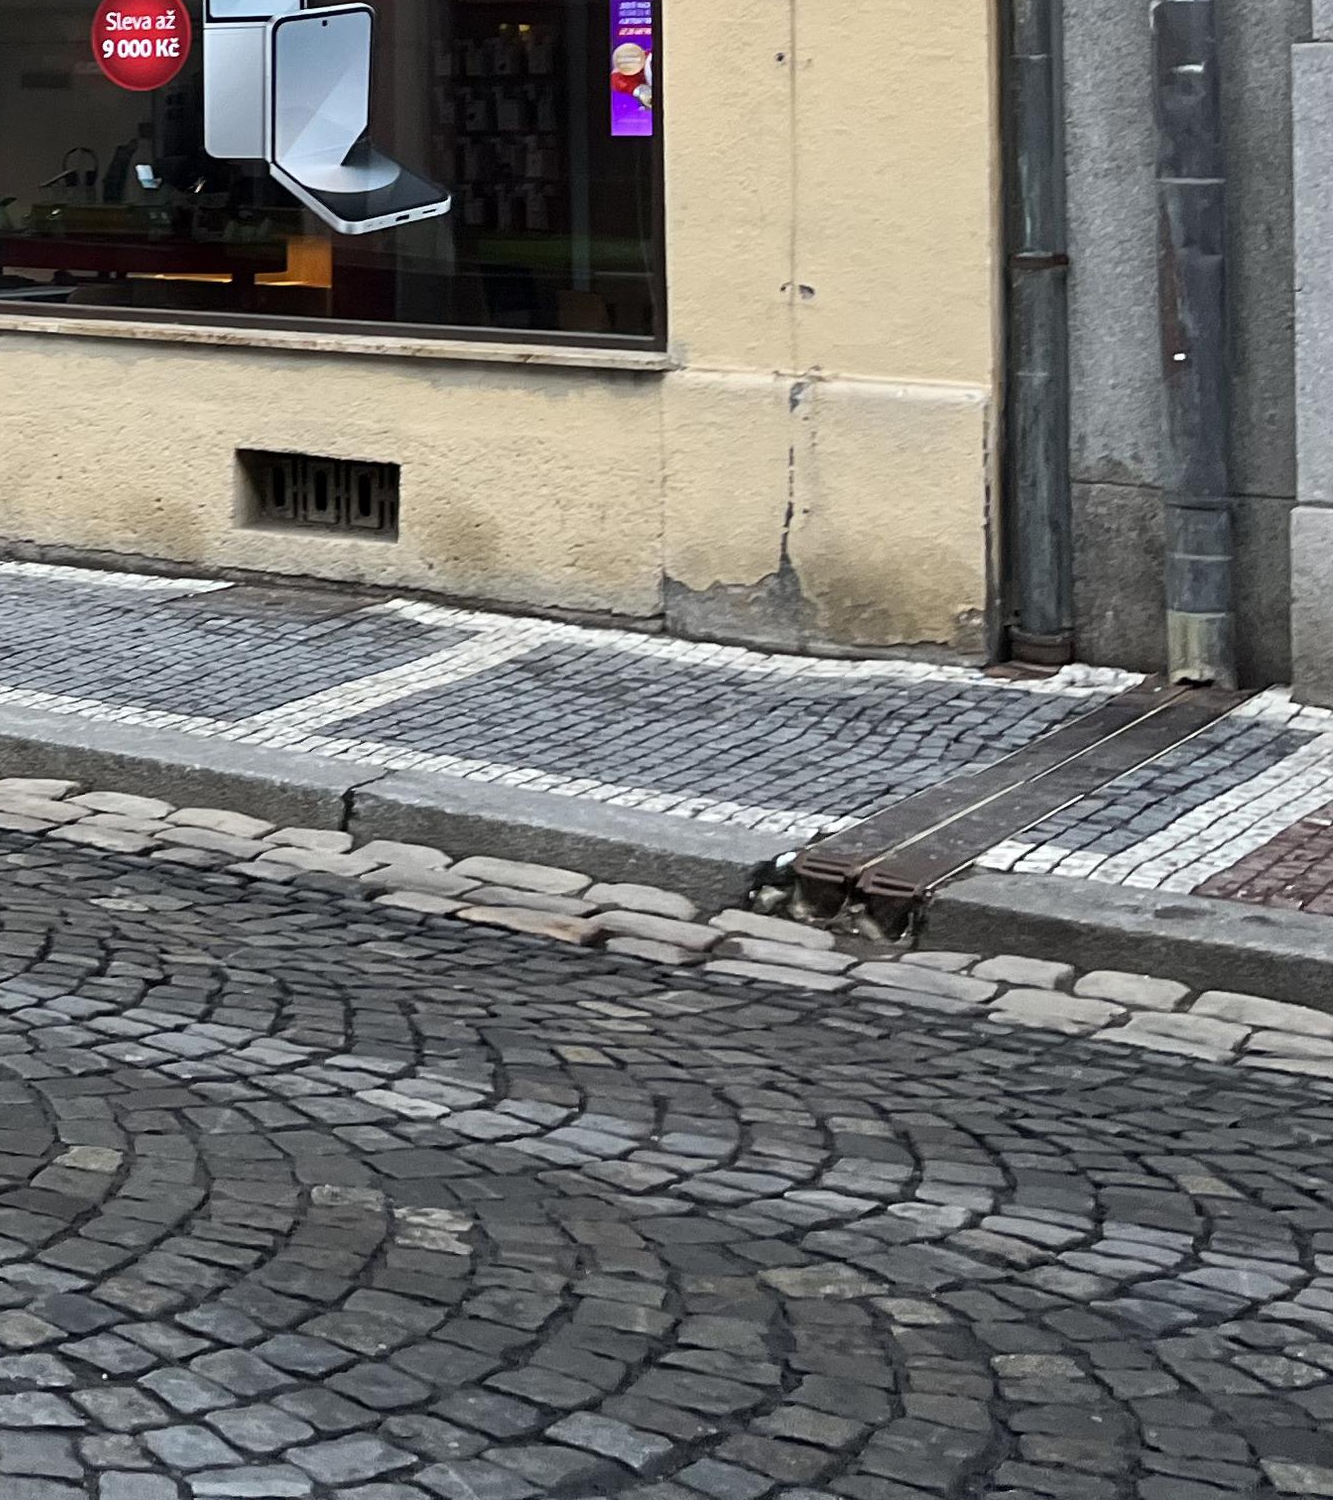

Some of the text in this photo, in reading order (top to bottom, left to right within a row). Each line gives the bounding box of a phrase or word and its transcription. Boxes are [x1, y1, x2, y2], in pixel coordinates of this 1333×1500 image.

[105, 9, 176, 31] Sleva až
[102, 37, 181, 58] 9 000 Kč
